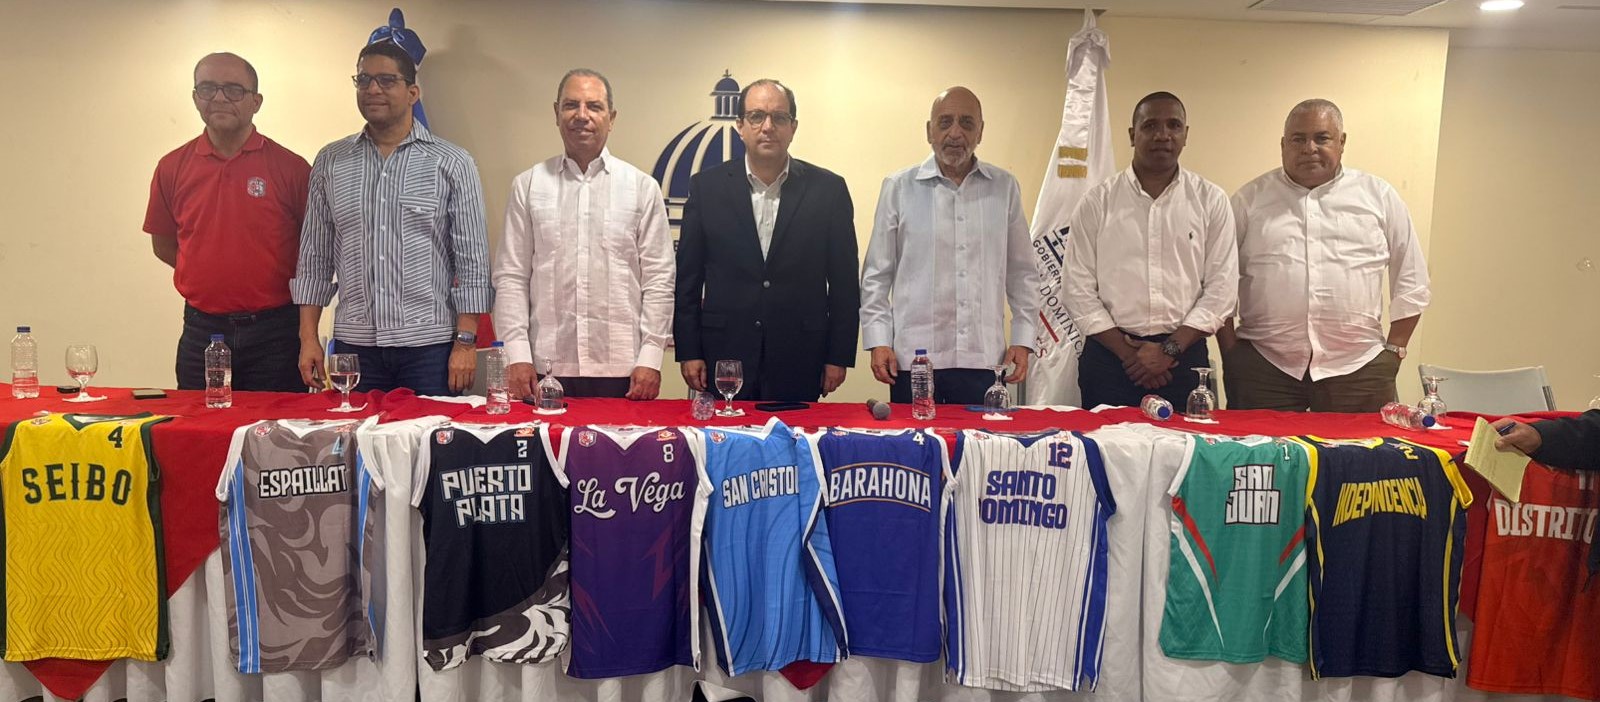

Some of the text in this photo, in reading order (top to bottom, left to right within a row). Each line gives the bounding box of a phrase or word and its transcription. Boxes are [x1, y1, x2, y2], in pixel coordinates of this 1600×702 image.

[1032, 239, 1062, 290] GOBIERN
[1040, 285, 1082, 357] DOMINIC
[108, 426, 123, 448] 4
[331, 435, 345, 457] 4
[517, 440, 528, 458] 2
[662, 443, 674, 463] 8
[912, 431, 925, 446] 4
[1399, 446, 1419, 460] 2
[1048, 441, 1073, 469] 12
[22, 463, 132, 505] SEIBO
[258, 464, 347, 498] ESPAILLAT
[440, 463, 533, 501] PUERTO
[722, 474, 750, 508] SAN
[829, 466, 932, 509] BARAHONA
[986, 470, 1057, 500] SANTO
[1233, 465, 1275, 491] SAN
[455, 494, 525, 527] PLATA
[573, 471, 685, 519] La Vega
[1224, 489, 1281, 525] JUAN
[978, 498, 1068, 530] OMINGO
